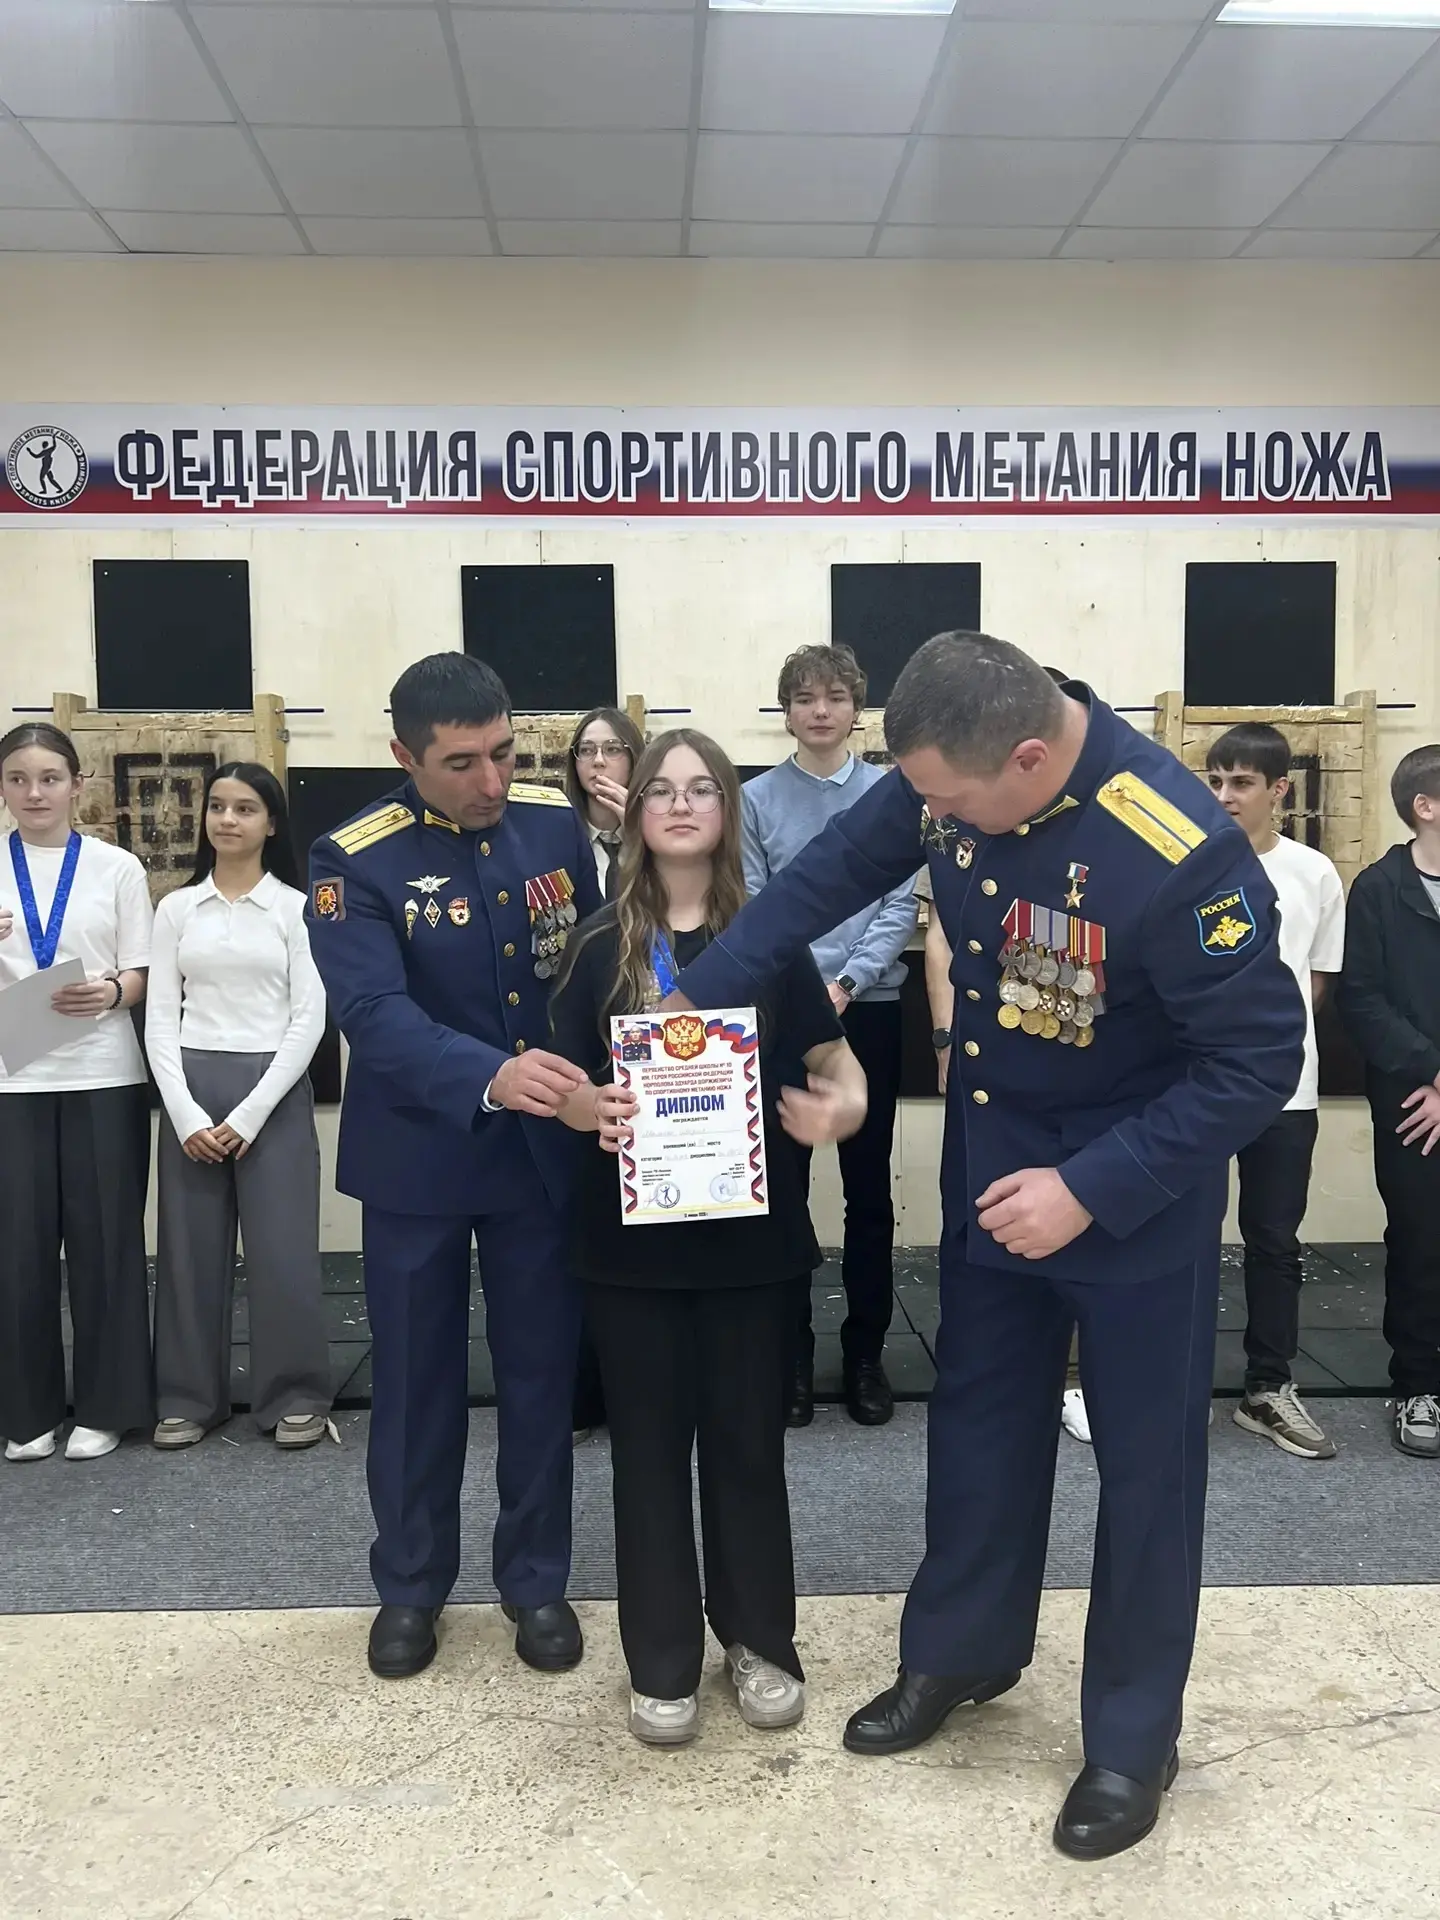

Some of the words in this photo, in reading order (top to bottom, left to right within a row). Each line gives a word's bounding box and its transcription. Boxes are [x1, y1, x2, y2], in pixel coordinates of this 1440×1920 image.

[9, 438, 26, 481] СПОРТИВНОЕ
[24, 428, 54, 440] МЕТАНИЕ
[60, 432, 78, 449] НОЖА
[117, 429, 478, 504] ФЕДЕРАЦИЯ
[505, 429, 907, 499] СПОРТИВНОГО
[934, 430, 1197, 498] МЕТАНИЯ
[1225, 430, 1388, 498] НОЖА
[20, 488, 48, 505] SPORTS
[49, 494, 72, 505] KNIFE
[70, 456, 86, 495] THROWING
[1199, 893, 1241, 917] РОССИЯ
[642, 1065, 675, 1073] ПЕРВЕНСТВО
[668, 1071, 702, 1079] РОССИЙСКОЙ
[653, 1087, 690, 1095] СПОРТИВНОМУ
[691, 1085, 716, 1093] МЕТАНИЮ
[656, 1094, 725, 1117] ДИПЛОМ
